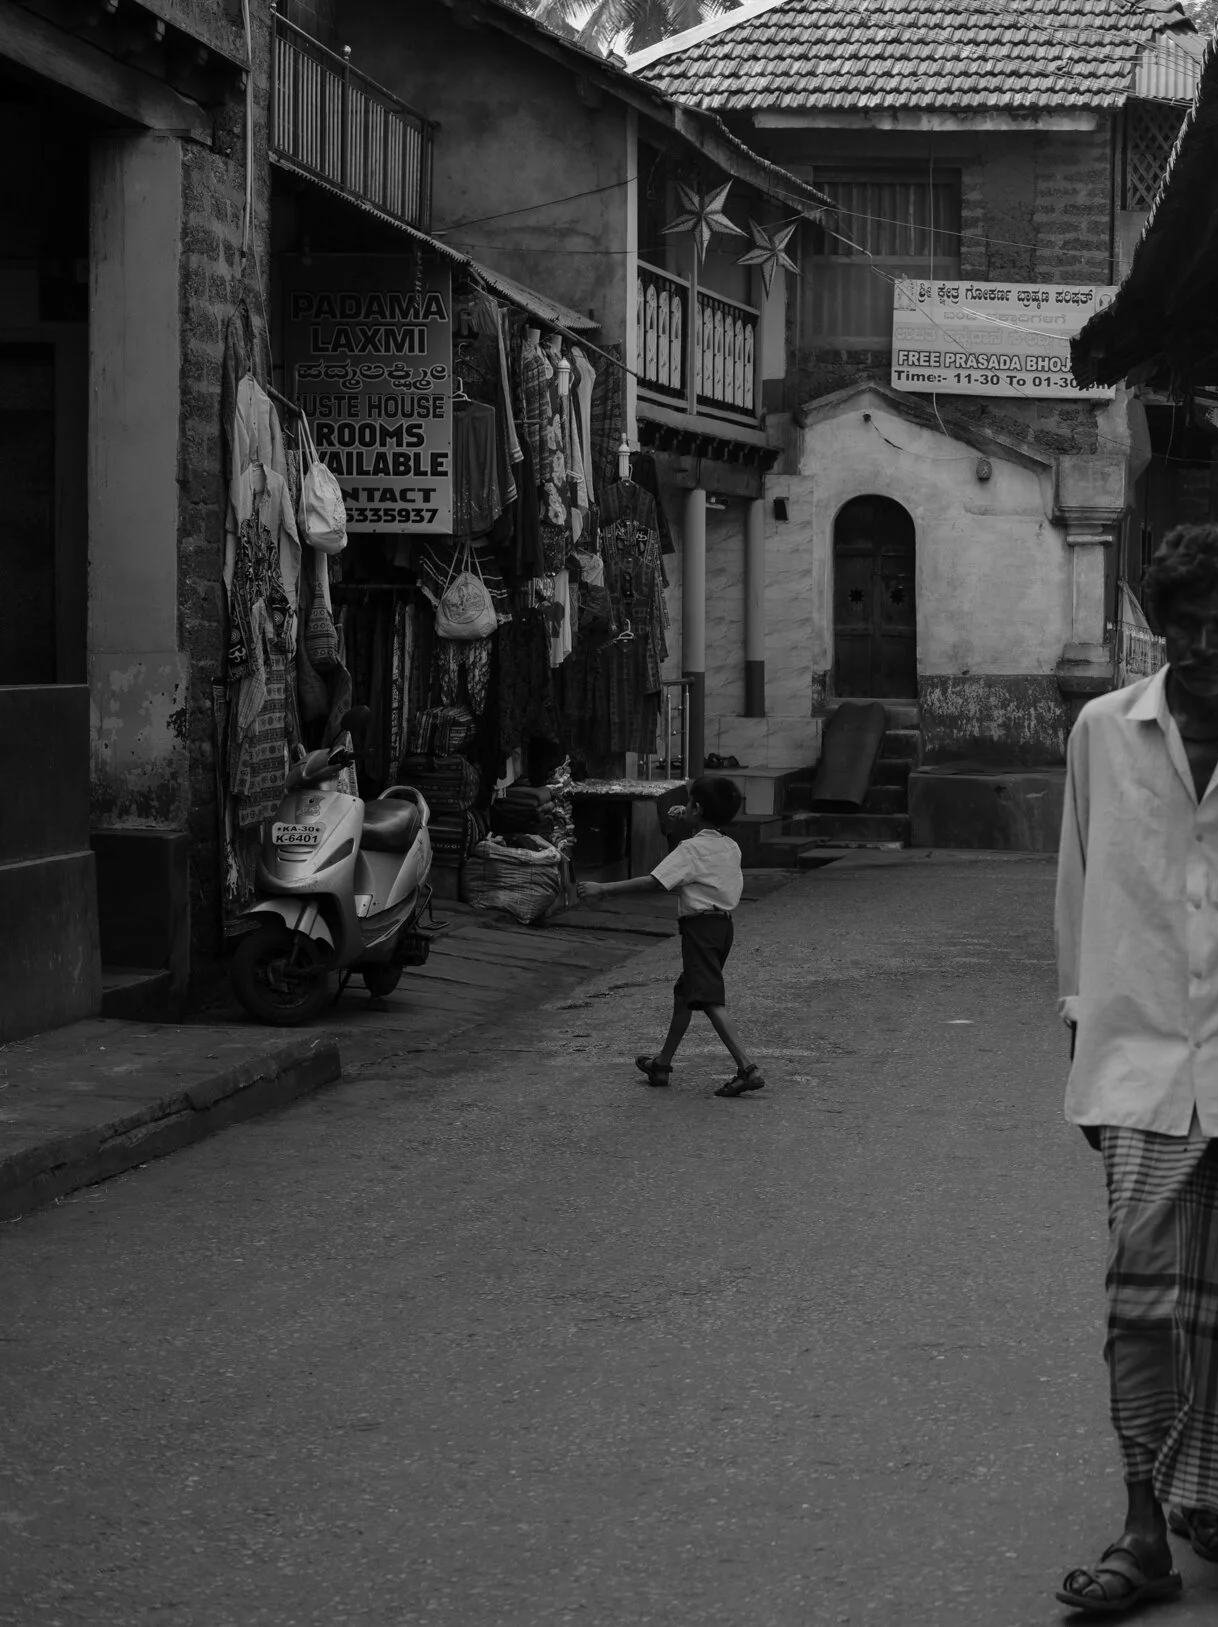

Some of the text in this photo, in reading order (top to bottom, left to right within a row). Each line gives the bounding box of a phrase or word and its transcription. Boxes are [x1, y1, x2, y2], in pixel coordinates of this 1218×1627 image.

[291, 291, 448, 322] PADAMA
[918, 283, 1094, 310] ಶ್ರೀ ಕ್ಷೇತ್ರ ಗೋಕರ್ಣ ಬ್ರಾಹ್ಮಣ ಪರಿಷತ್
[309, 324, 428, 355] LAXMI
[897, 350, 1072, 373] FREE PRASADA BHOJ
[954, 373, 1000, 386] 11-30
[1006, 375, 1027, 388] To
[1032, 376, 1079, 389] 01-30
[297, 393, 444, 419] USTE HOUSE
[315, 422, 425, 448] ROOMS
[340, 487, 437, 503] NTACT
[275, 834, 319, 844] K-6401
[282, 825, 315, 833] KA-30
